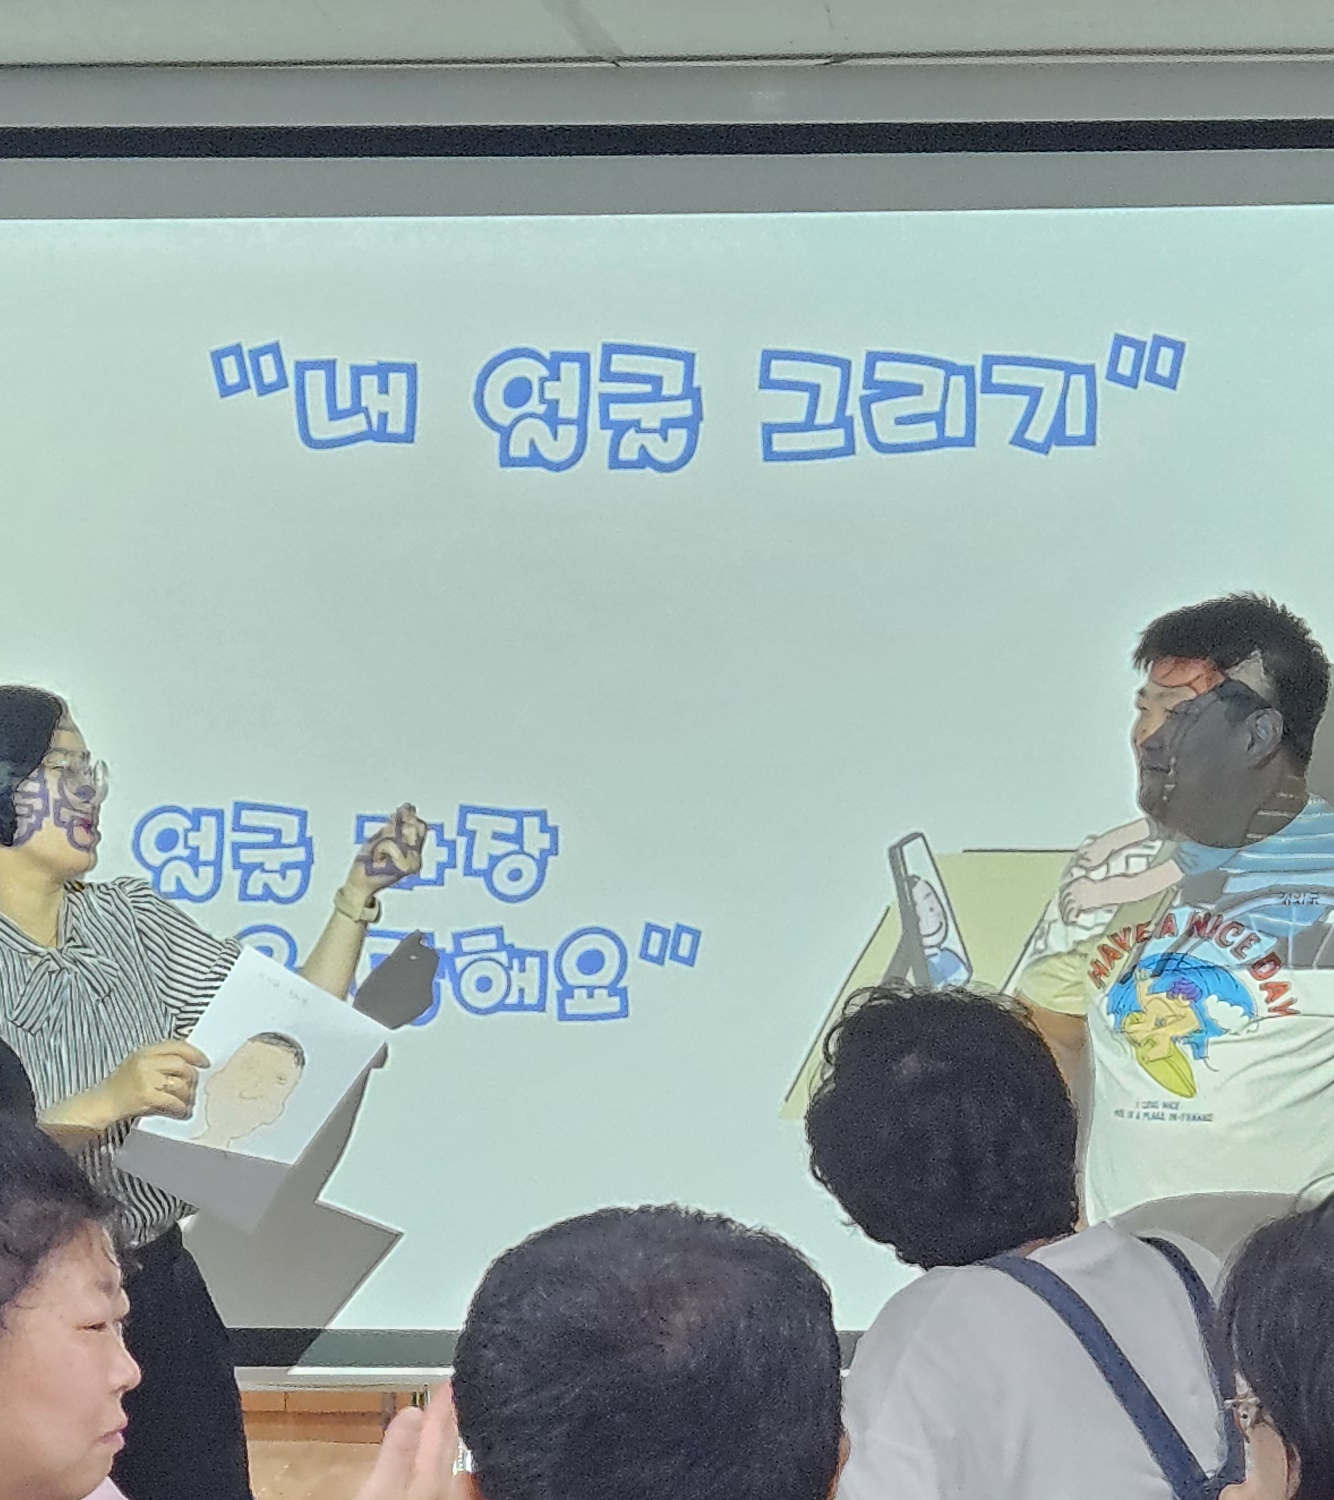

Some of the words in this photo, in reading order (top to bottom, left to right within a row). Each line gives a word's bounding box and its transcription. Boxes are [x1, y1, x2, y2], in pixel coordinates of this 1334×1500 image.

[474, 341, 704, 474] 얼굴
[132, 801, 314, 904] 얼굴
[356, 802, 559, 903] 장
[1087, 920, 1151, 990] HAVE
[1156, 912, 1179, 939] A
[1188, 909, 1262, 960] NICE
[1247, 951, 1301, 1016] DAY
